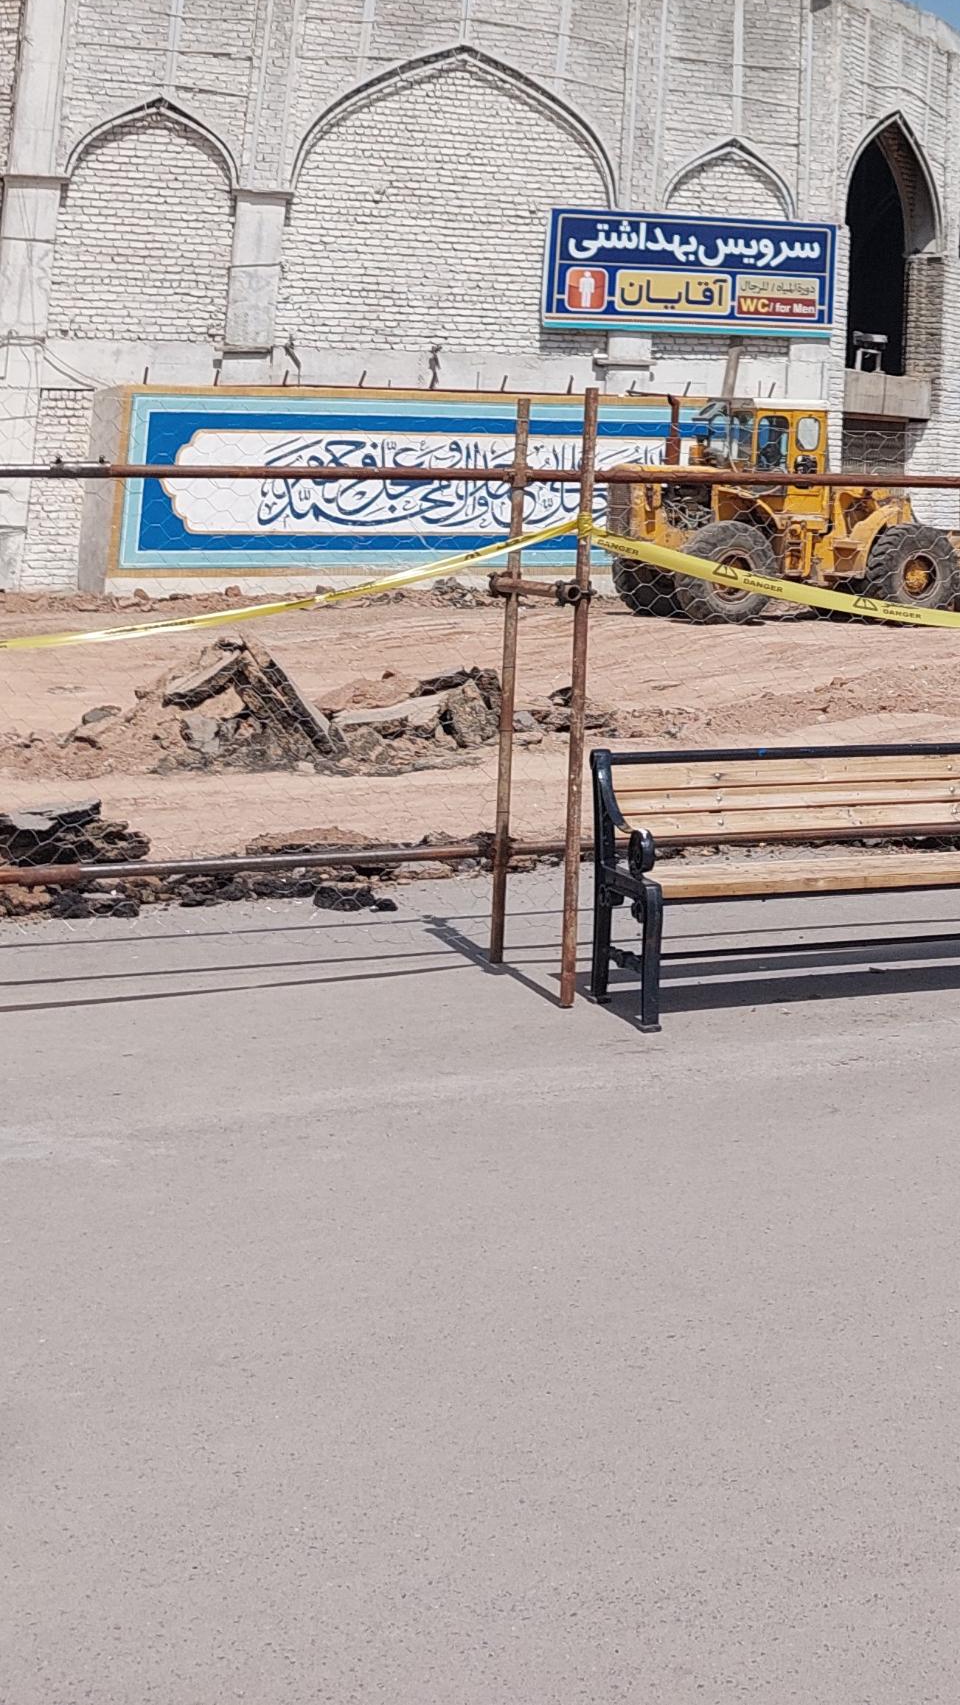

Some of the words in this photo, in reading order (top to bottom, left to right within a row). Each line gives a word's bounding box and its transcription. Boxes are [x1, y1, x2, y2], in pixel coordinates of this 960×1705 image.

[568, 220, 698, 262] بهداشتی
[698, 235, 821, 267] سرویس
[619, 276, 728, 311] آقایان
[775, 302, 792, 314] for
[793, 303, 816, 314] Men
[742, 577, 785, 593] DANGER
[882, 608, 923, 620] DANGER
